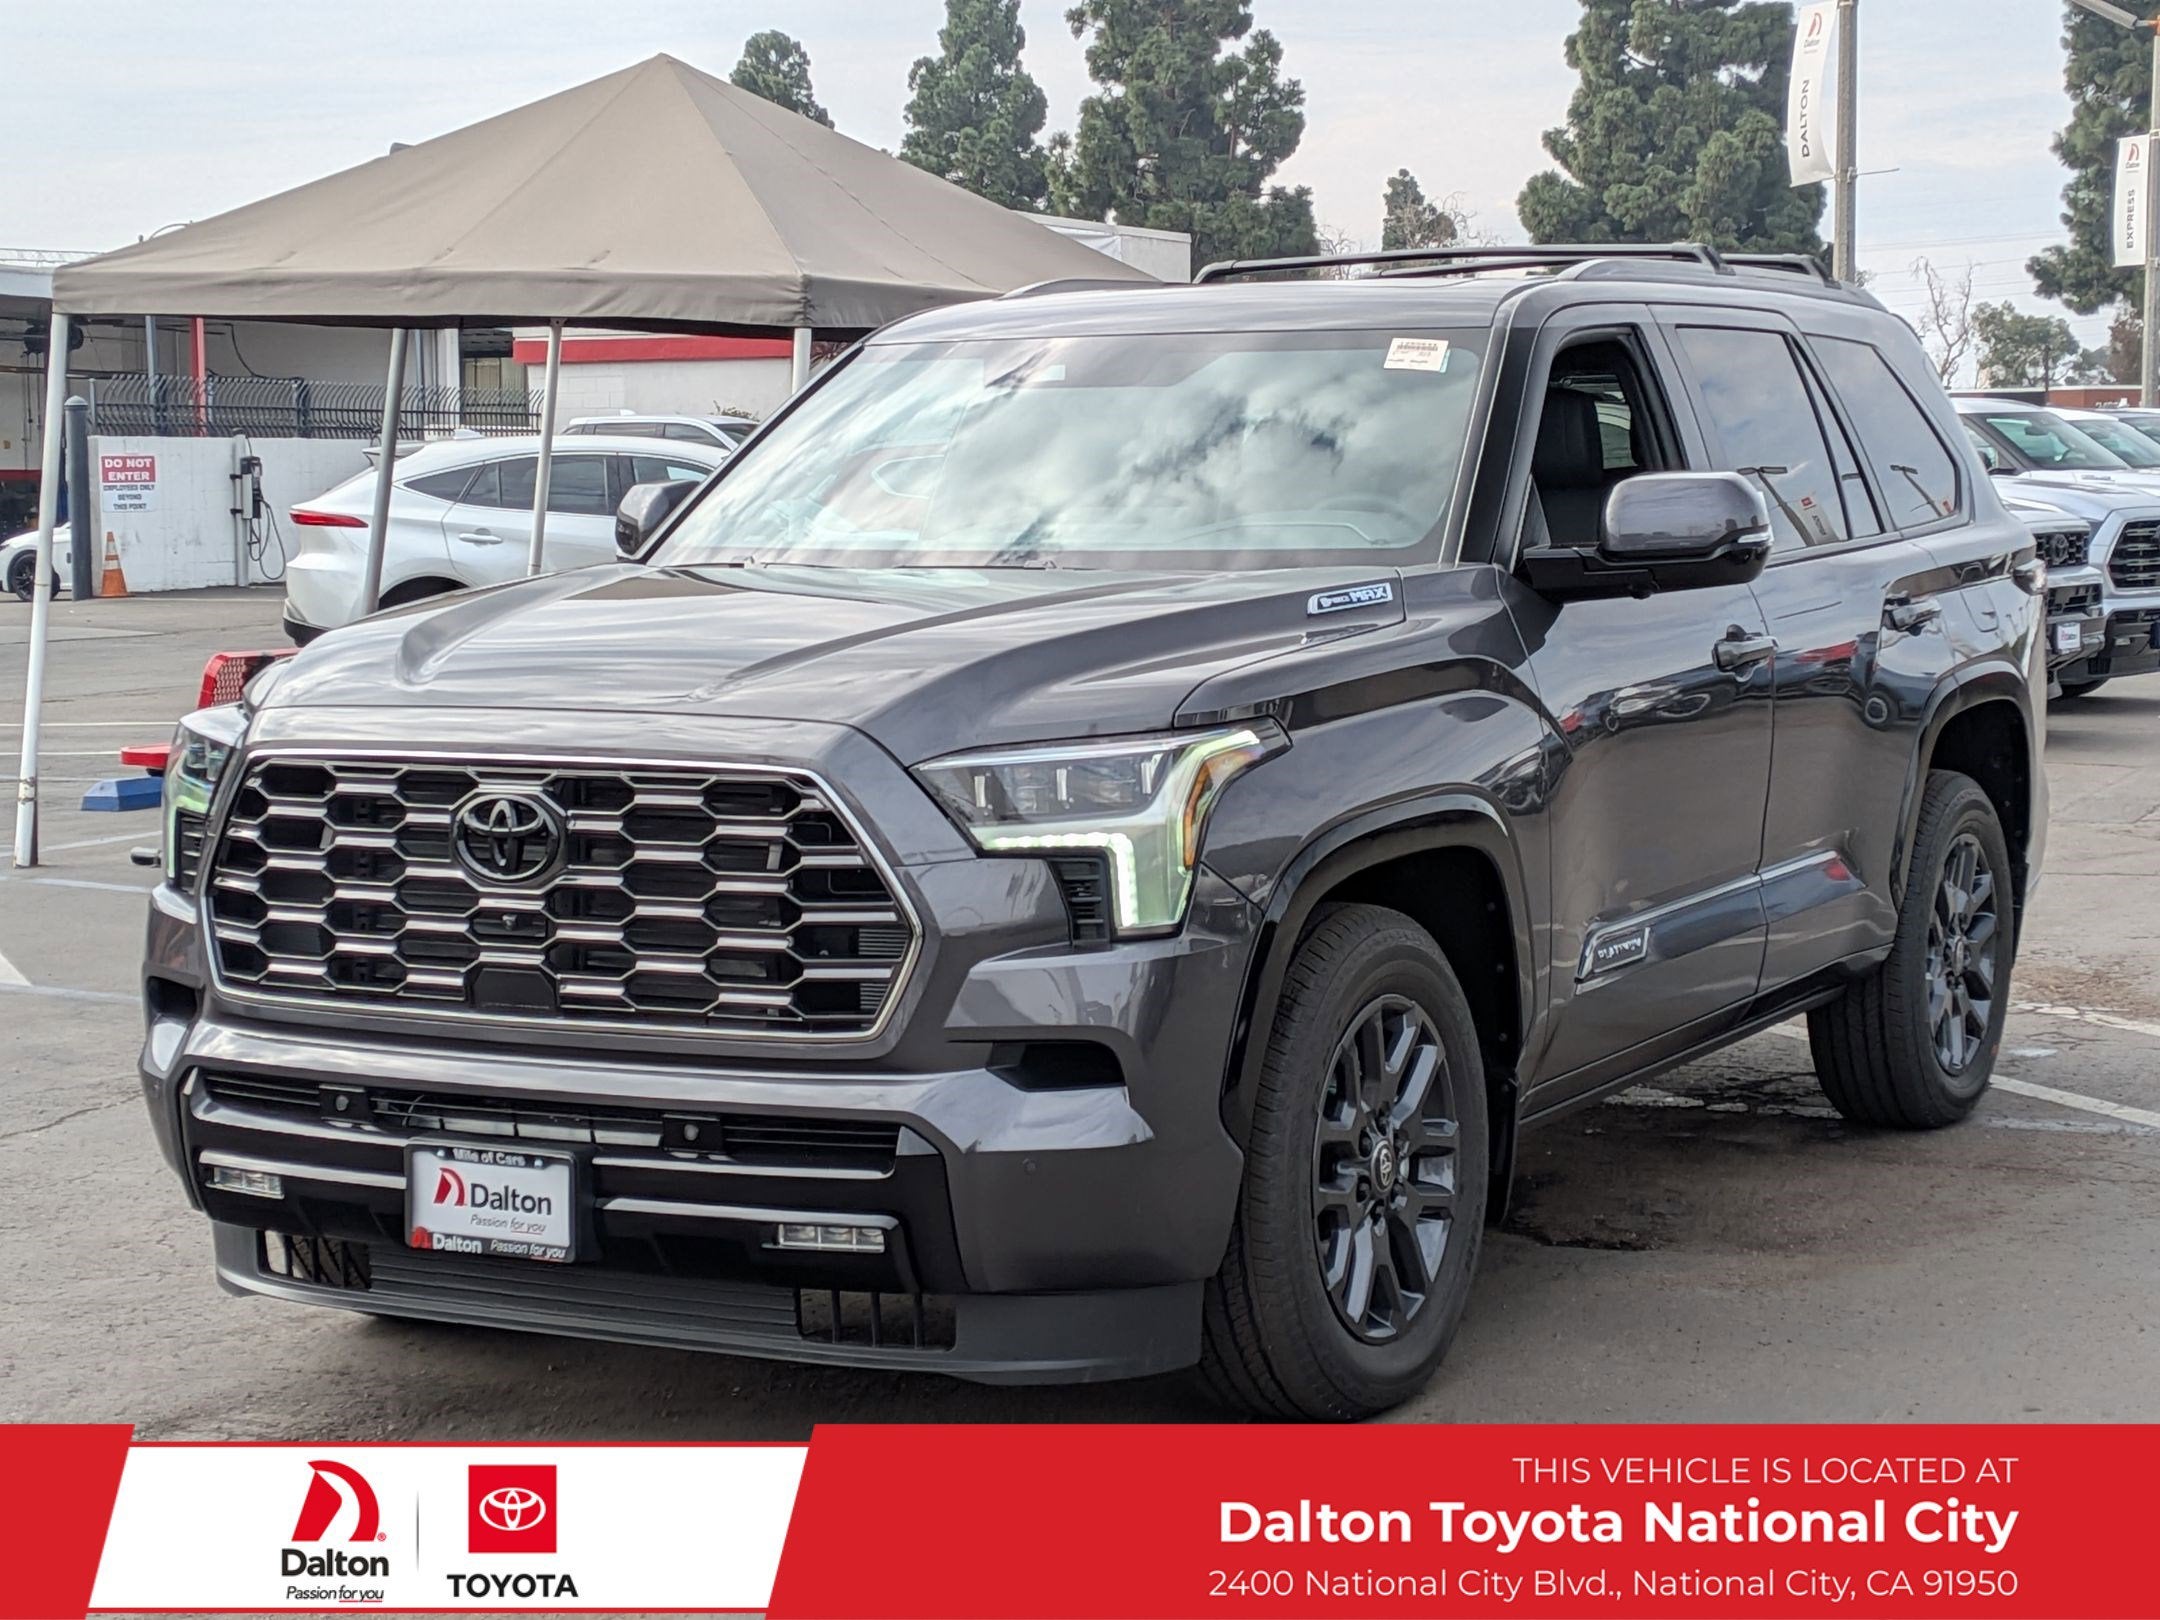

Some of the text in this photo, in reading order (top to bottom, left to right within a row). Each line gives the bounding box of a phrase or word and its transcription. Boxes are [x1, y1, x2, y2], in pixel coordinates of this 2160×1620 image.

[1800, 79, 1810, 158] DALTON
[2126, 189, 2135, 249] EXPRESS
[104, 458, 152, 468] DO NOT
[108, 471, 150, 481] ENTER
[1349, 587, 1387, 603] MAX
[452, 1148, 526, 1167] Mile of Cars
[470, 1183, 552, 1216] Dalton
[470, 1214, 546, 1233] Passion for you
[432, 1233, 567, 1259] Dalton Passion for you
